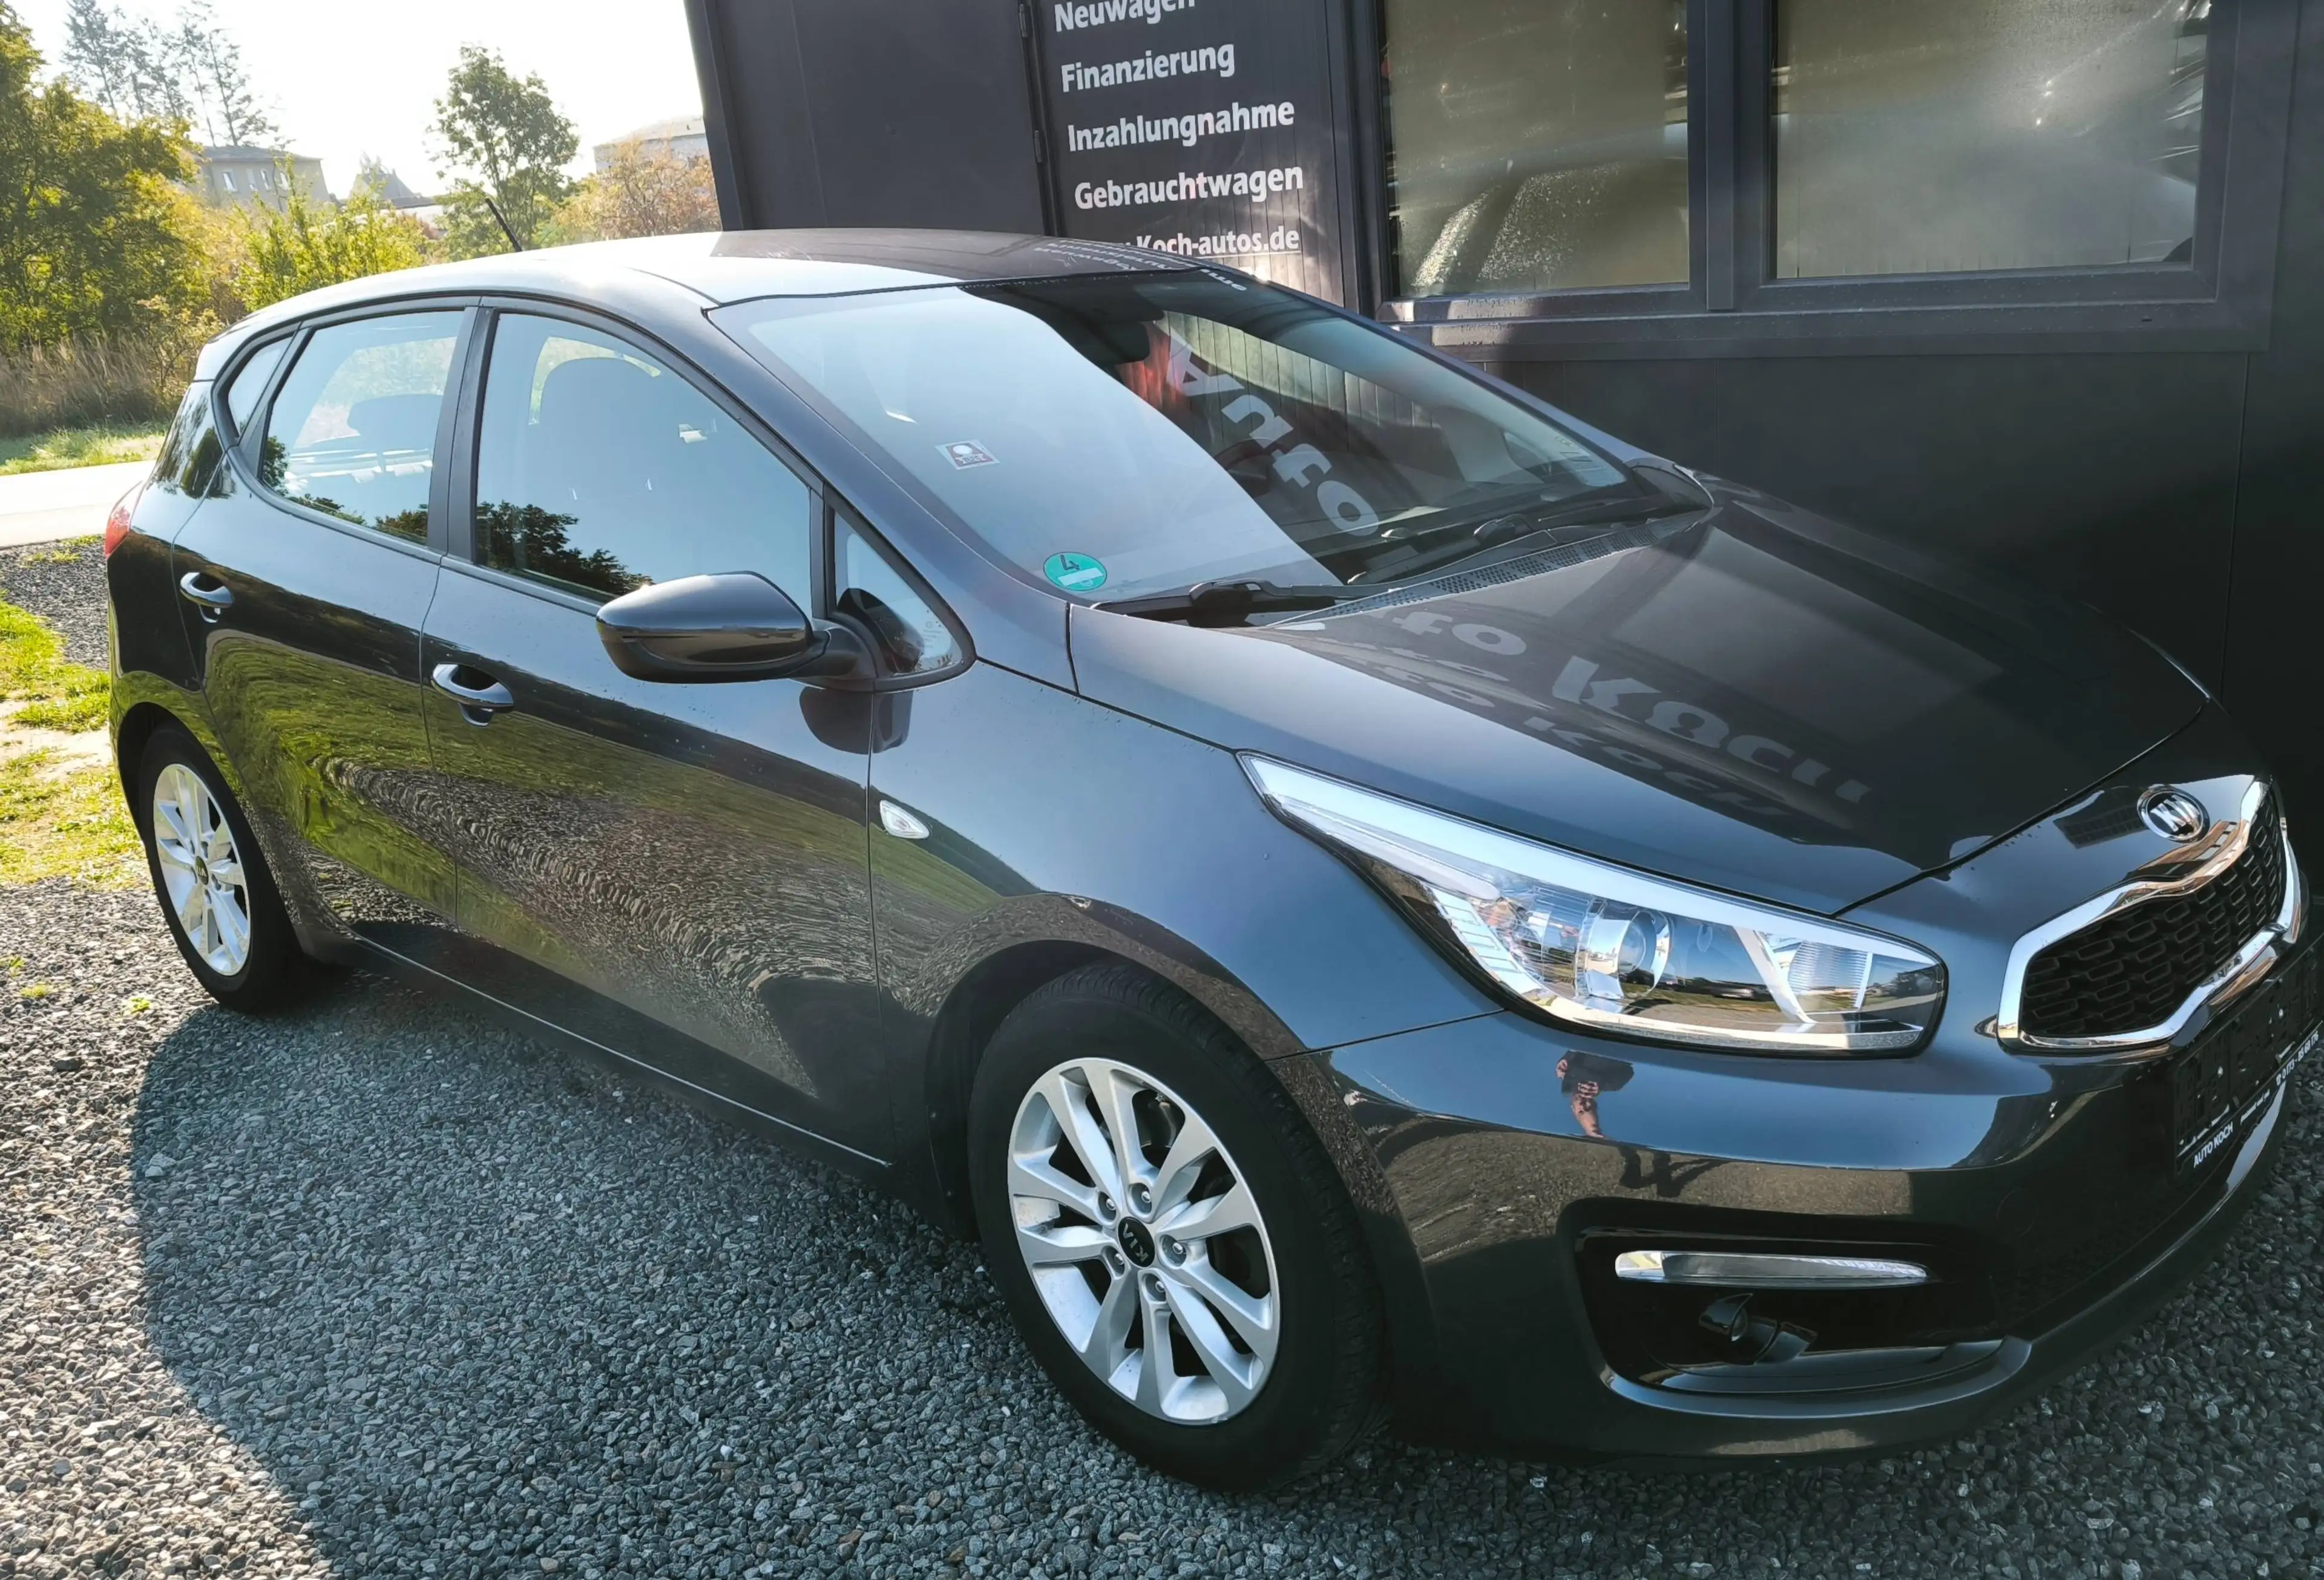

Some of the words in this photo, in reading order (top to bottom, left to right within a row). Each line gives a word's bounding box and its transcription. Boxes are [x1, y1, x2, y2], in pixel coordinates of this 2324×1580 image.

[1061, 44, 1235, 93] Finanzierung
[1068, 102, 1295, 152] Inzahlungnahme
[1075, 166, 1304, 210] Gebrauchtwagen
[1126, 225, 1301, 255] Koch-autos.de
[1059, 554, 1080, 571] 4
[2193, 1141, 2213, 1169] AUTO
[2213, 1121, 2233, 1149] KOCH
[1122, 1222, 1149, 1264] KIA
